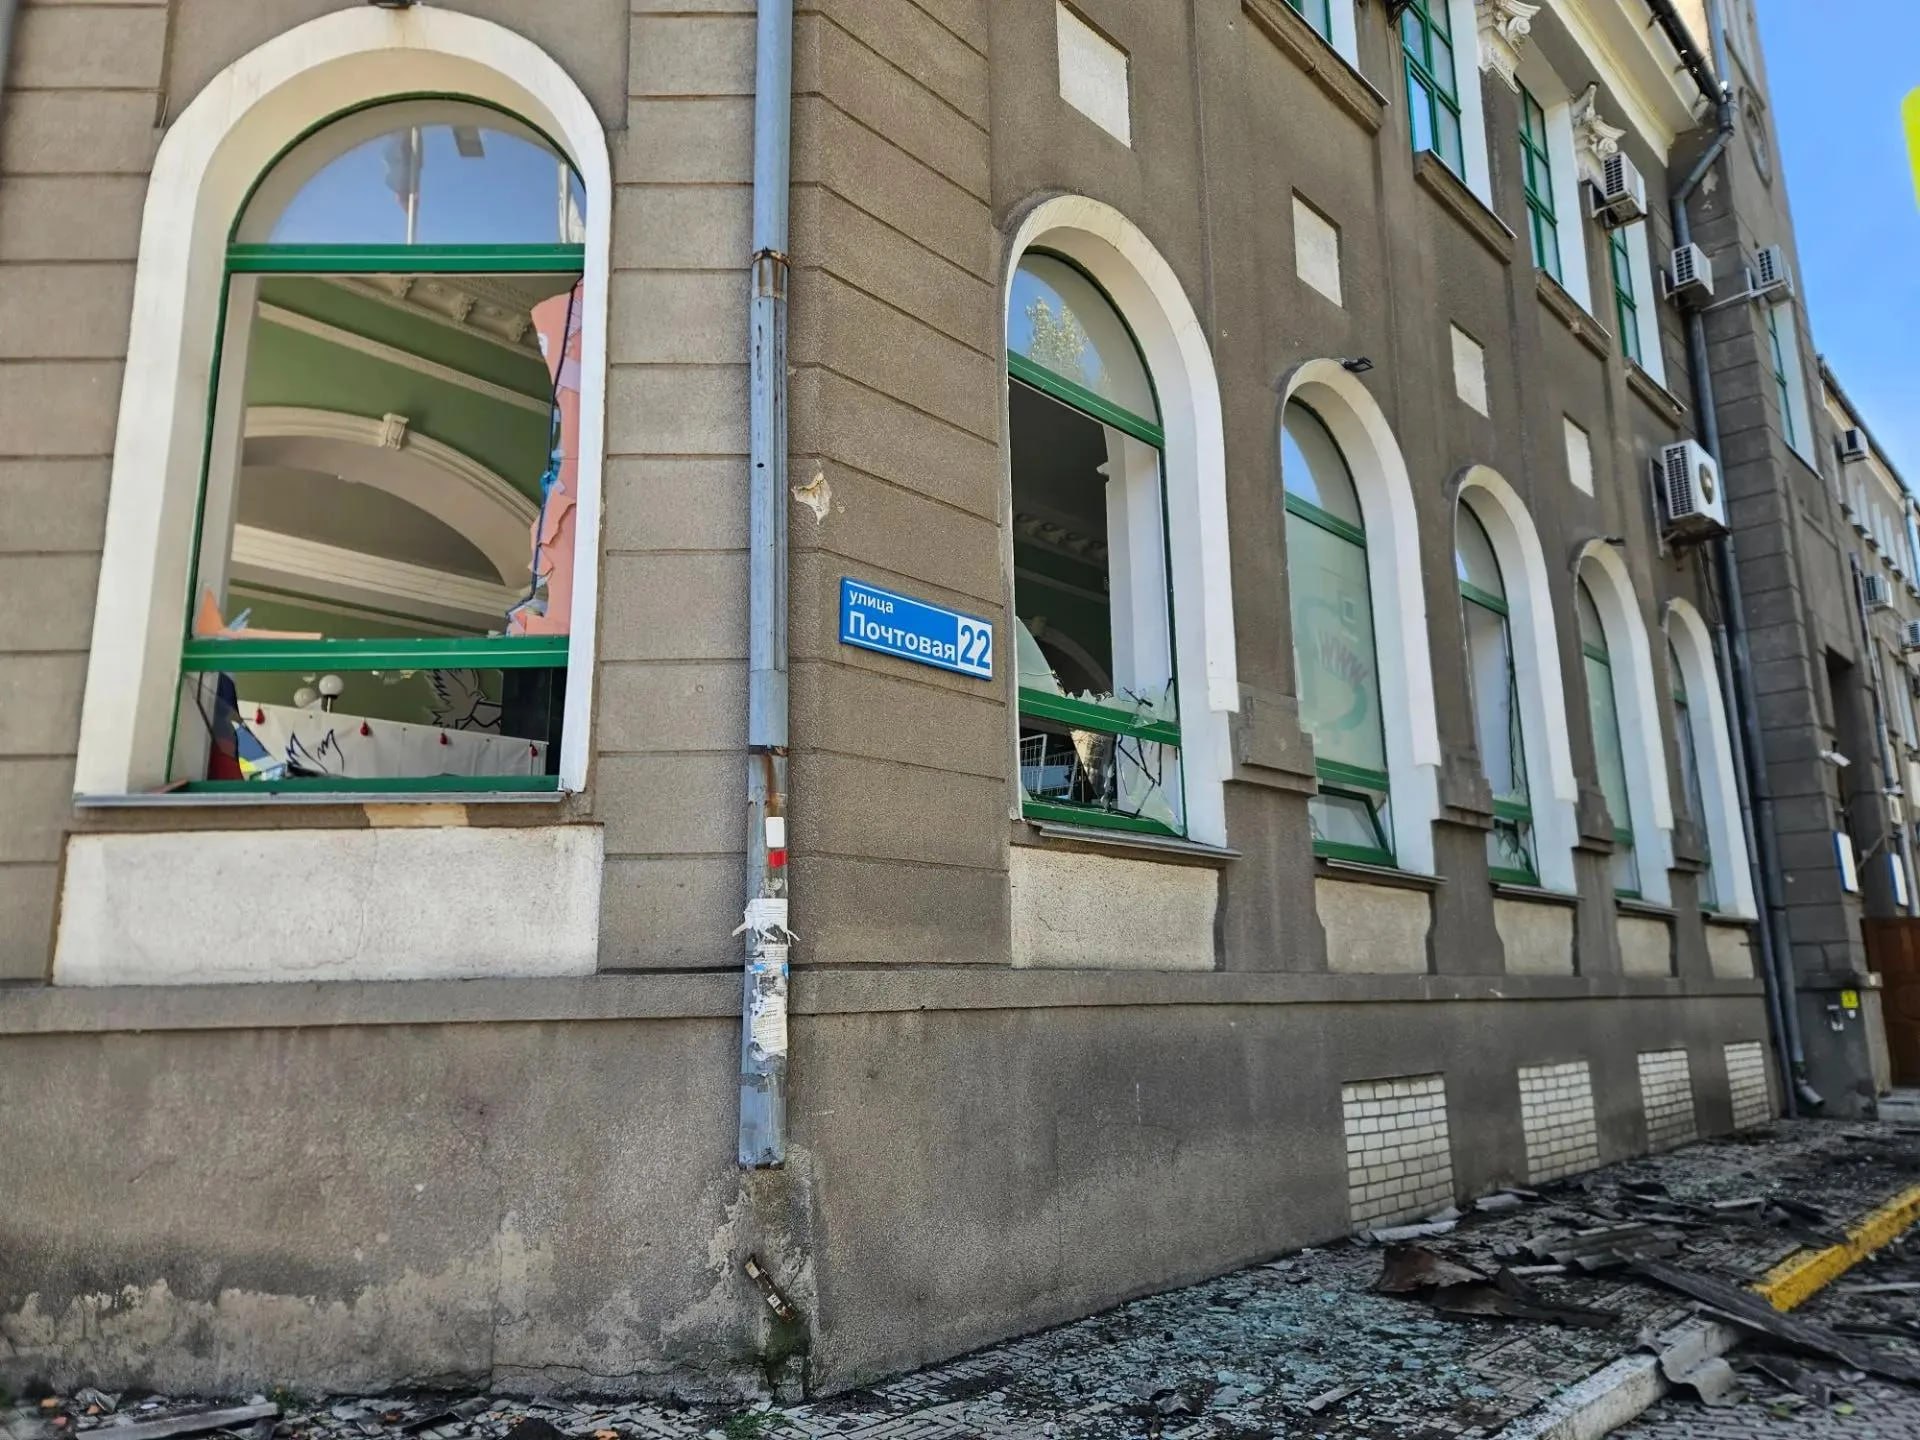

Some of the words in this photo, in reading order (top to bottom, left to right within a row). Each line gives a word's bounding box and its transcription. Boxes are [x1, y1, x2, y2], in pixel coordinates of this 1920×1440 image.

[849, 590, 894, 614] улица
[849, 610, 956, 661] Почтовая
[960, 624, 991, 670] 22
